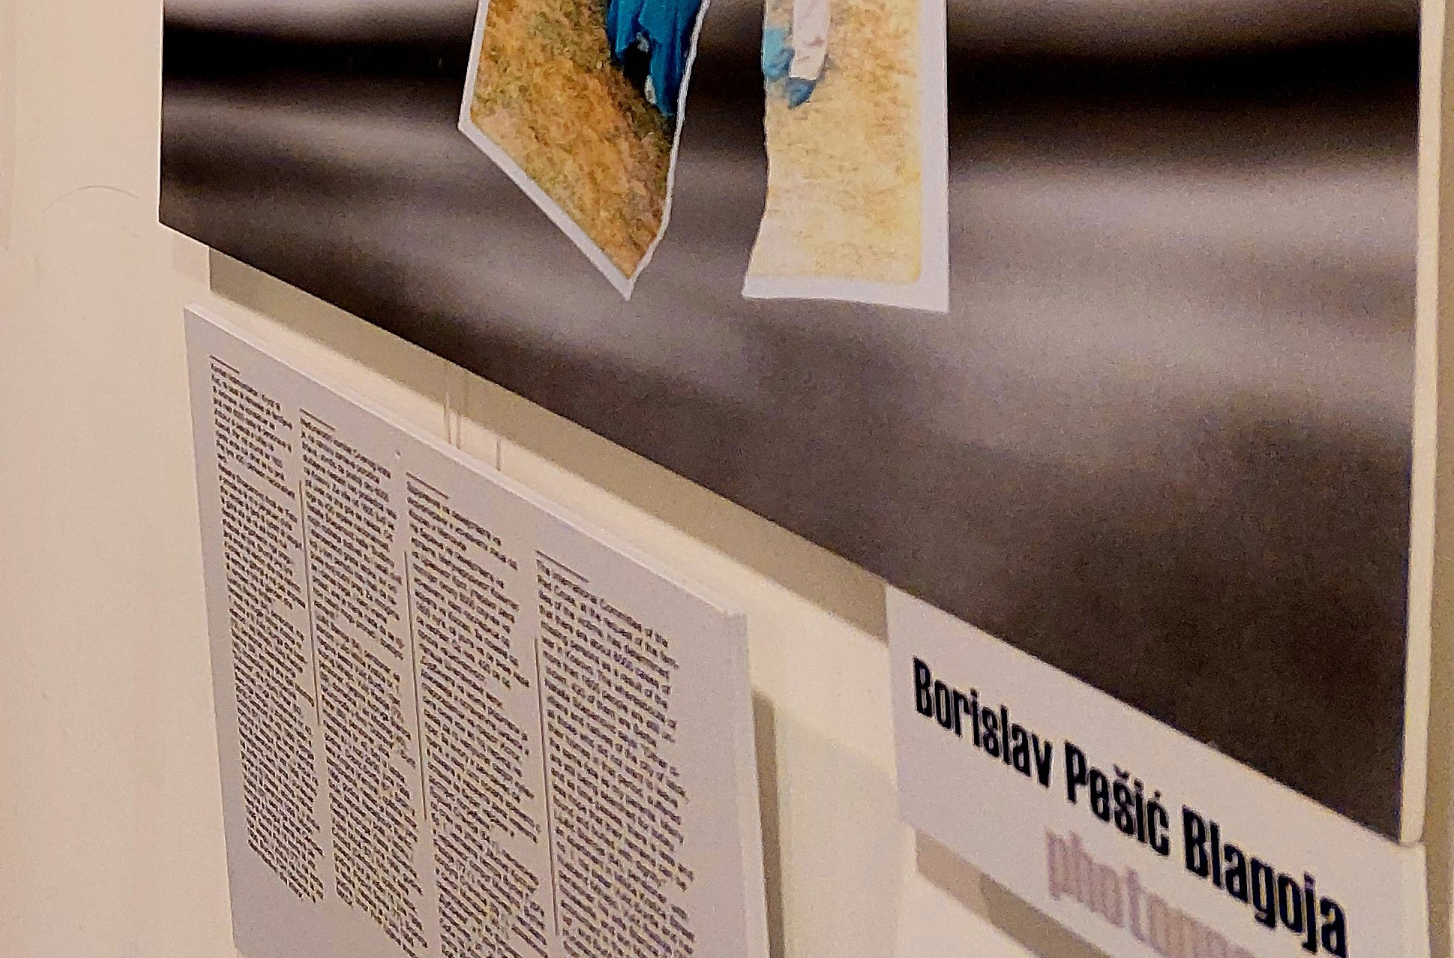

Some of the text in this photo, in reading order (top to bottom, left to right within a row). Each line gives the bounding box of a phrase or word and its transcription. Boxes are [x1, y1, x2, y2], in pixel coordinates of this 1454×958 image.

[913, 656, 1347, 958] Borislav Pešić Blagoja
